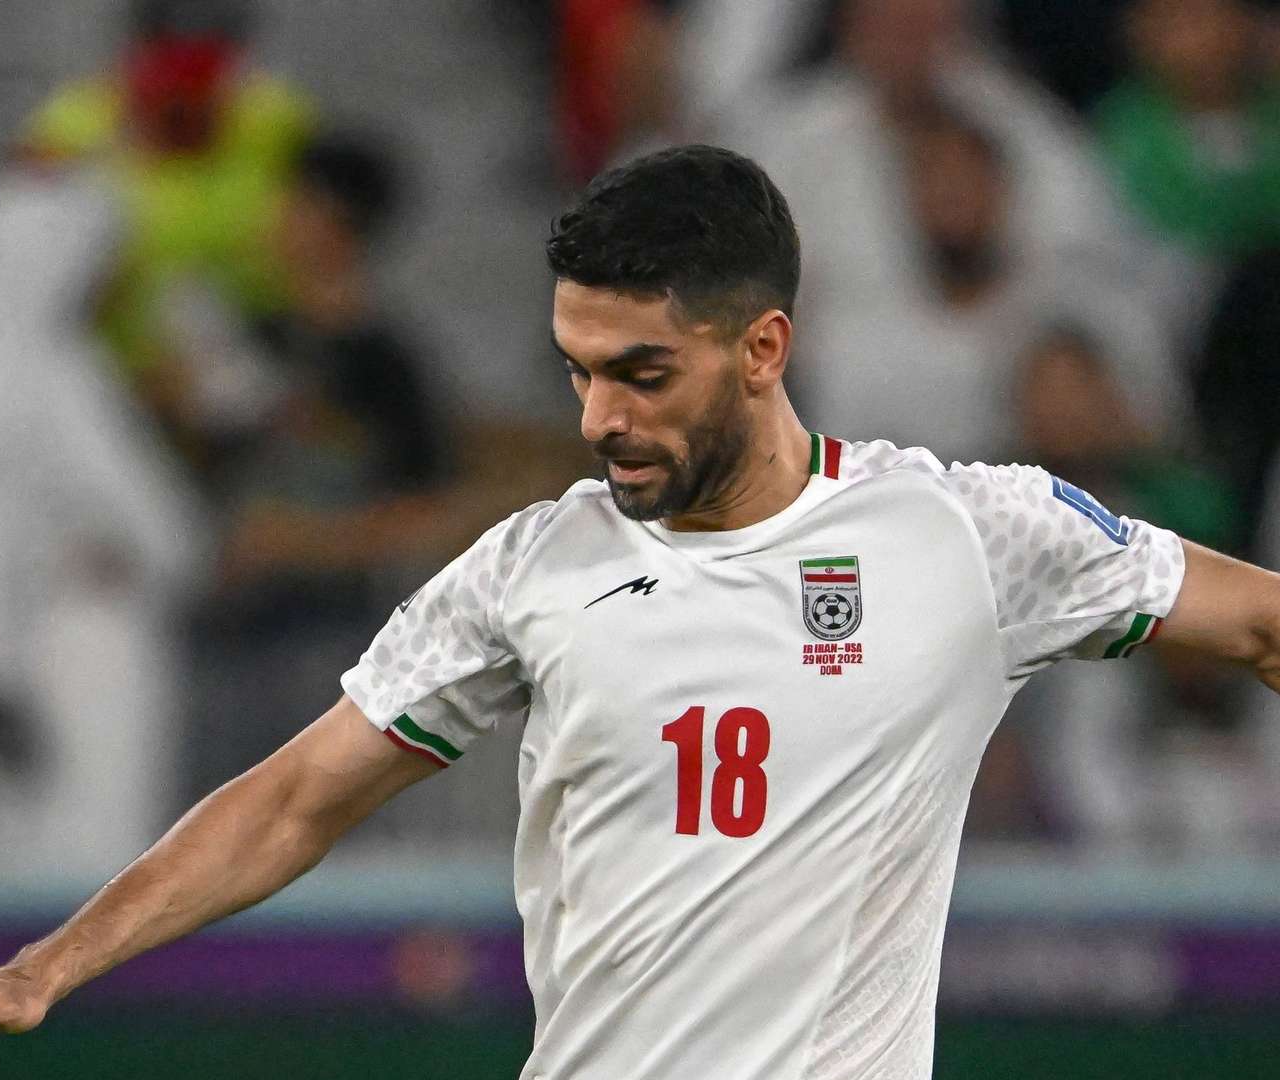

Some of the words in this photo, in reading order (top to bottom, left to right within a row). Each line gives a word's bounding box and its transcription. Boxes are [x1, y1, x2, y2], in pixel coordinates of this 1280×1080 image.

[802, 654, 815, 665] 29
[815, 654, 836, 665] NOV
[837, 653, 863, 664] 2022
[661, 706, 771, 838] 18
